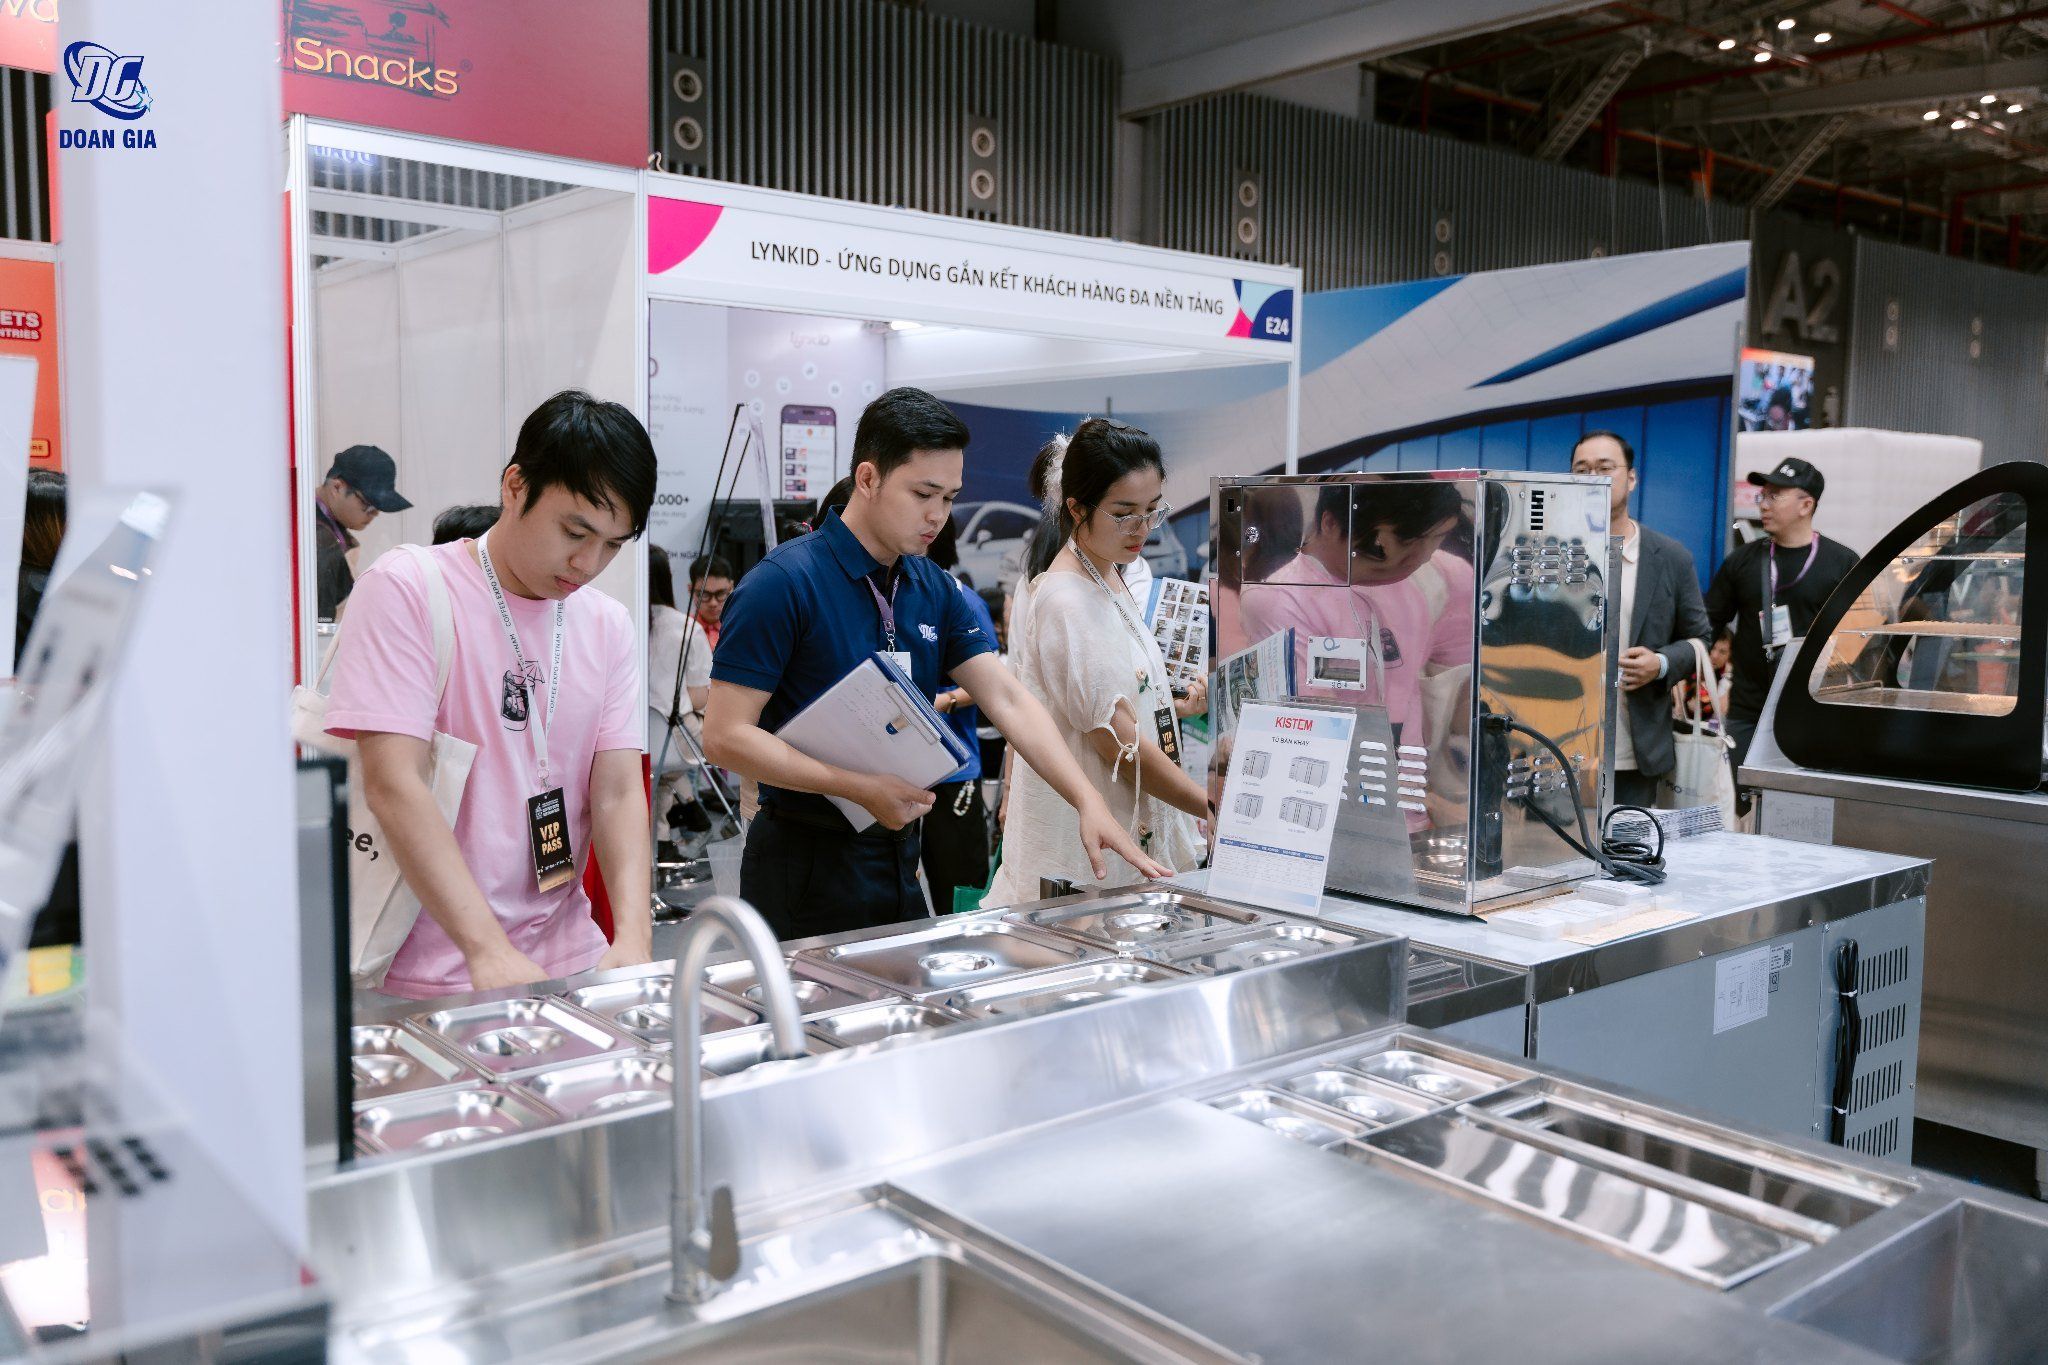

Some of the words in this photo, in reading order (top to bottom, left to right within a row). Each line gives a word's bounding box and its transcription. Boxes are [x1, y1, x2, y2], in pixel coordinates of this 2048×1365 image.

[294, 37, 458, 95] Snacks
[751, 240, 819, 267] LYNKID
[838, 248, 882, 274] ỨNG
[888, 258, 941, 282] DỤNG
[947, 260, 984, 287] GẮN
[990, 266, 1019, 290] KẾT
[1024, 274, 1076, 297] KHÁCH
[1082, 280, 1125, 303] HÀNG
[1129, 288, 1150, 304] ĐA
[1155, 286, 1185, 308] NỀN
[1188, 293, 1224, 316] TẢNG
[1761, 250, 1841, 343] A2
[1265, 316, 1290, 336] E24
[481, 549, 495, 581] VIETNAM
[490, 580, 503, 600] EXPO
[498, 600, 512, 627] COFFEE
[1275, 716, 1313, 731] KISTEM
[540, 822, 560, 841] VIP
[541, 837, 563, 856] PASS
